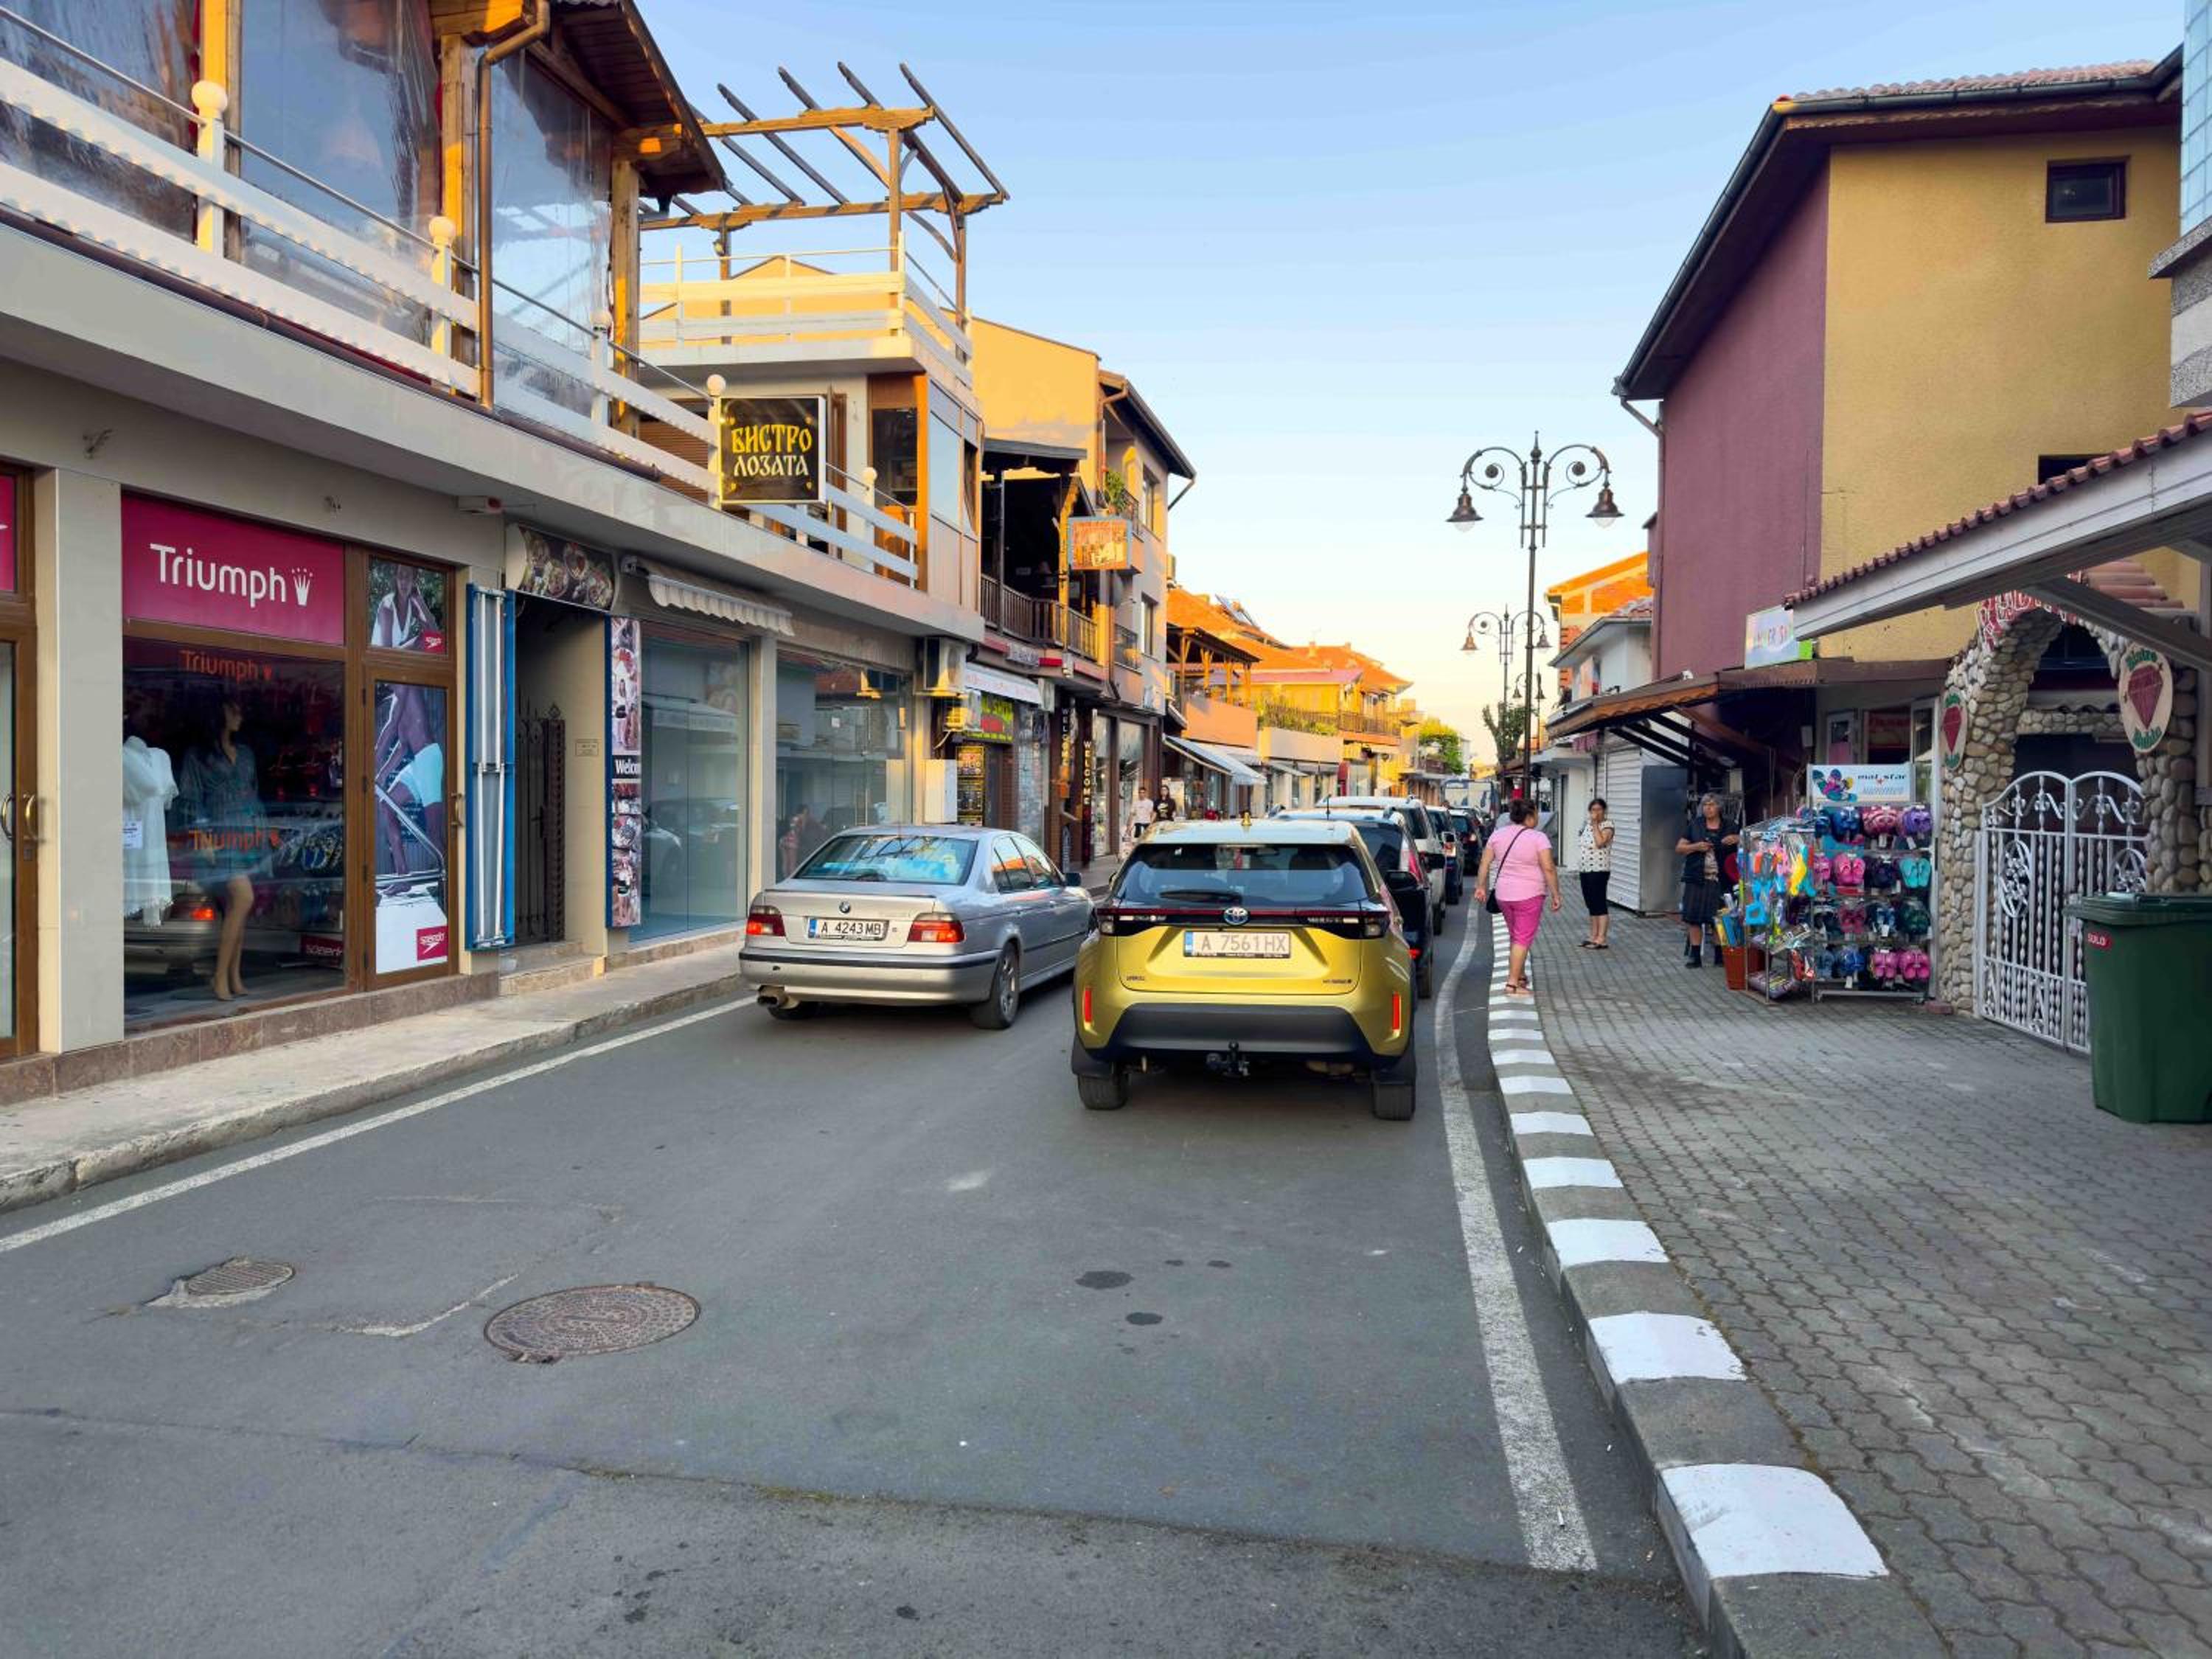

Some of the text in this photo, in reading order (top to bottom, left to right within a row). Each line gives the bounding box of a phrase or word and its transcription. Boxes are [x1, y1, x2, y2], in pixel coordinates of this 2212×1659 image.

[731, 424, 813, 453] БИСТРО
[733, 455, 810, 477] ЛОЗАТА
[150, 543, 286, 608] Triumph
[178, 649, 258, 684] Triumph
[1083, 740, 1092, 805] WELCOME
[189, 828, 265, 854] Triumph
[821, 922, 828, 933] A
[1202, 934, 1211, 951] A
